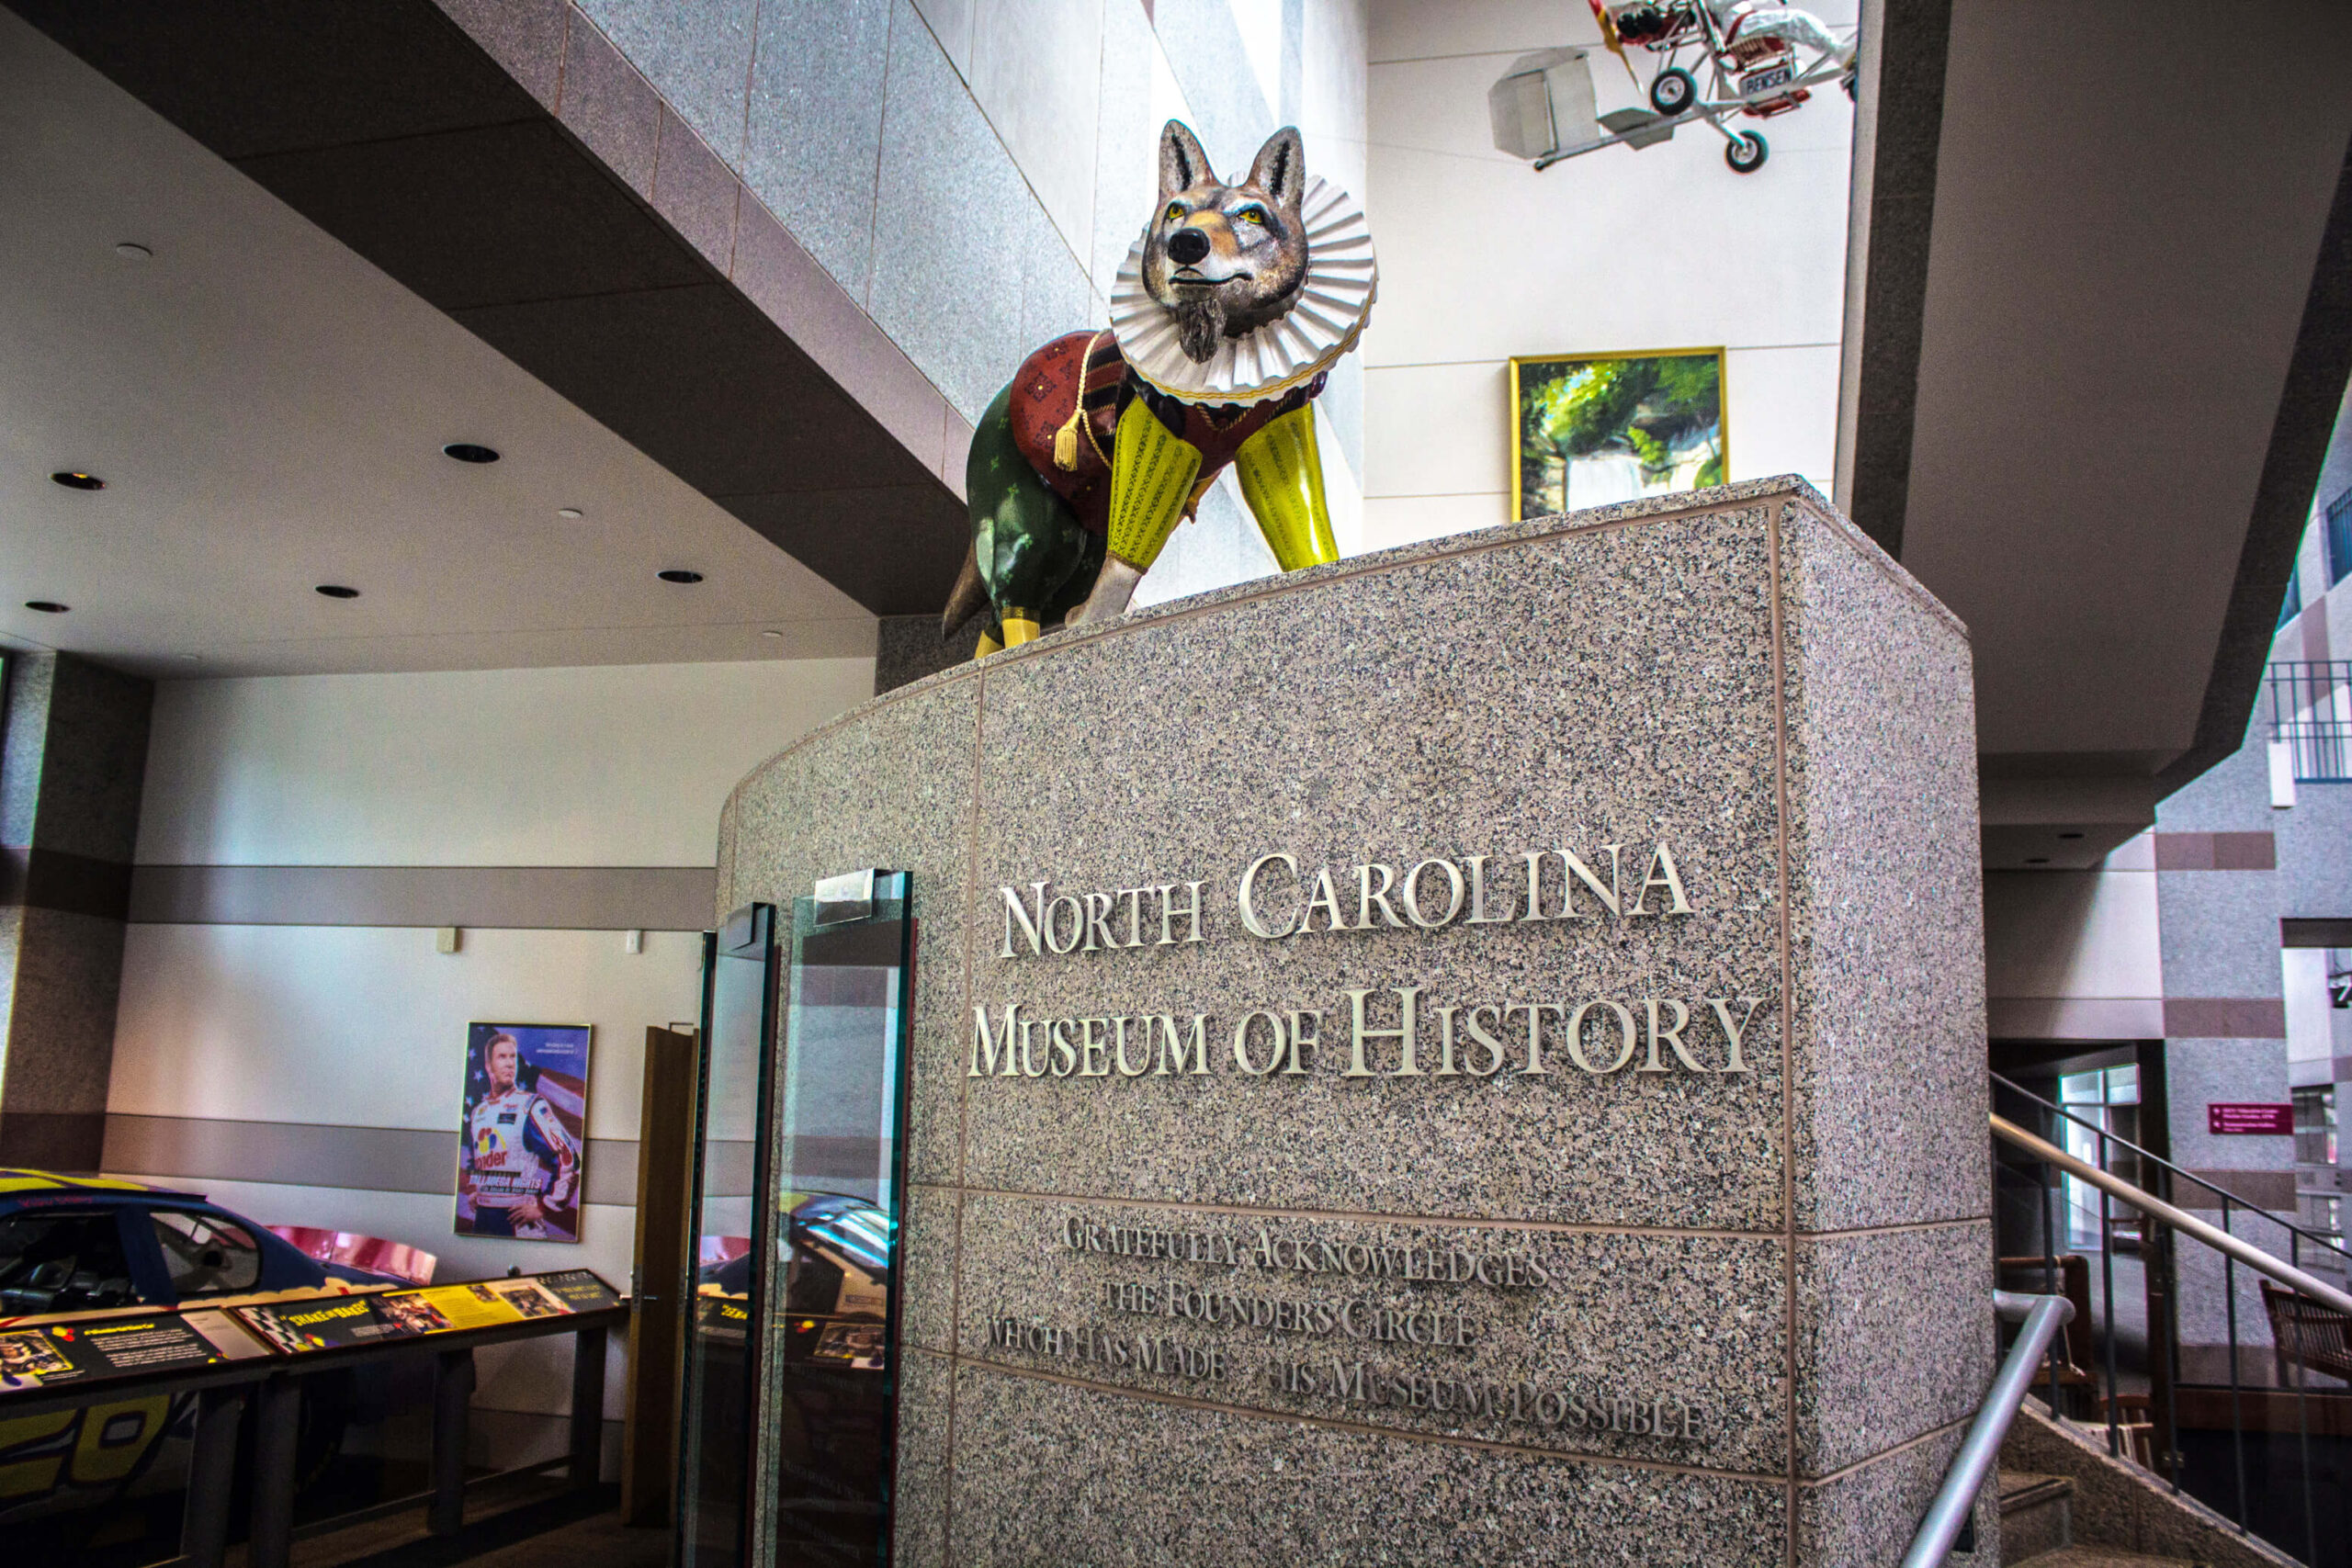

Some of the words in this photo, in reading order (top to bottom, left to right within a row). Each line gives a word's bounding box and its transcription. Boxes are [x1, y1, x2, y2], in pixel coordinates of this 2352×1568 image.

[999, 880, 1206, 959] NORTH
[1238, 840, 1697, 939] CAROLINA
[967, 1003, 1213, 1078] MUSEUM
[1234, 1010, 1324, 1077] OF
[1340, 986, 1770, 1077] HISTORY
[1063, 1216, 1240, 1266] GRATEFULLY
[1250, 1227, 1551, 1287] ACKNOWLEDGES
[1103, 1281, 1157, 1314] THE
[1167, 1280, 1334, 1334] FOUNDERS
[1341, 1297, 1477, 1348] CIRCLE
[986, 1314, 1065, 1356] WHICH
[1073, 1324, 1128, 1367] HAS
[1136, 1334, 1226, 1379] MADE
[1327, 1356, 1495, 1419] MUSEUM
[1510, 1379, 1707, 1441] POSSIBLE
